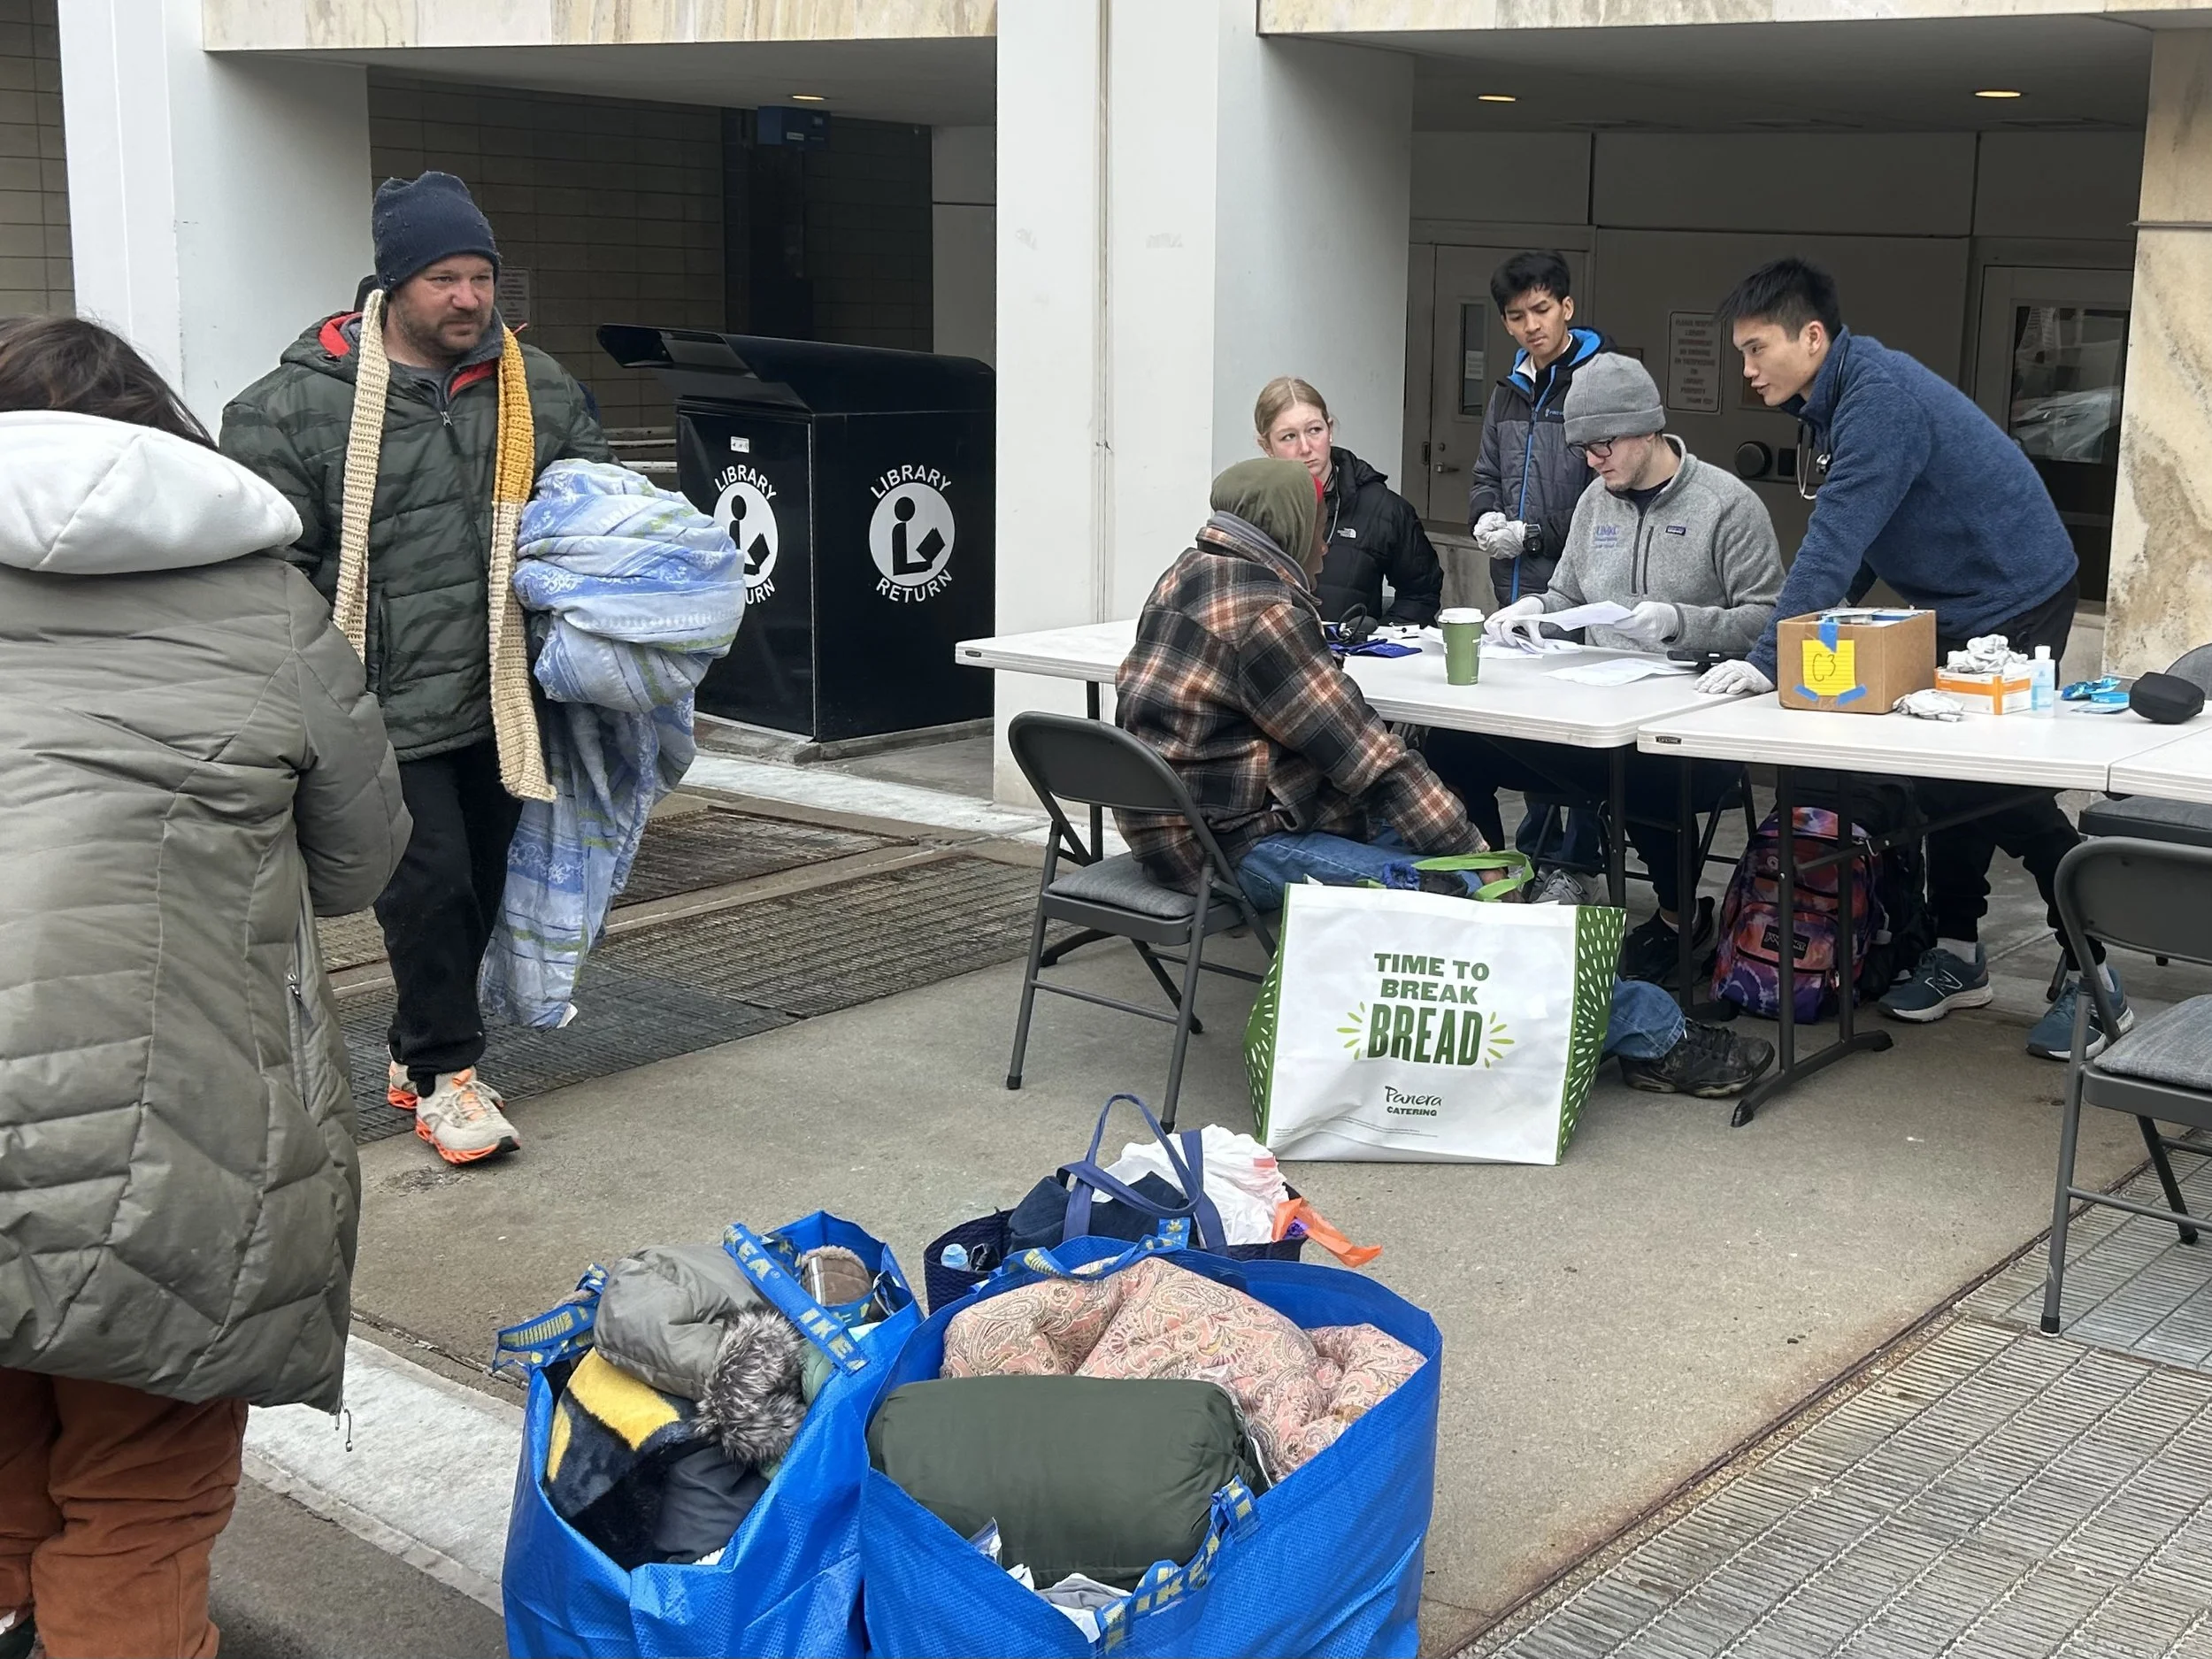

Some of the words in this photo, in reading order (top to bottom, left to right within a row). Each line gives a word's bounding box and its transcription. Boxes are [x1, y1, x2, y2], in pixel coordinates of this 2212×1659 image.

[715, 465, 777, 500] LIBRARY
[871, 465, 952, 499] LIBRARY
[746, 578, 776, 605] URN
[876, 569, 953, 603] RETURN
[1374, 953, 1445, 978] TIME
[1453, 961, 1490, 980] TO
[1380, 979, 1479, 1004] BREAK
[1367, 1004, 1483, 1066] BREAD
[1385, 1086, 1442, 1107] Panera
[1386, 1106, 1438, 1117] CATERING
